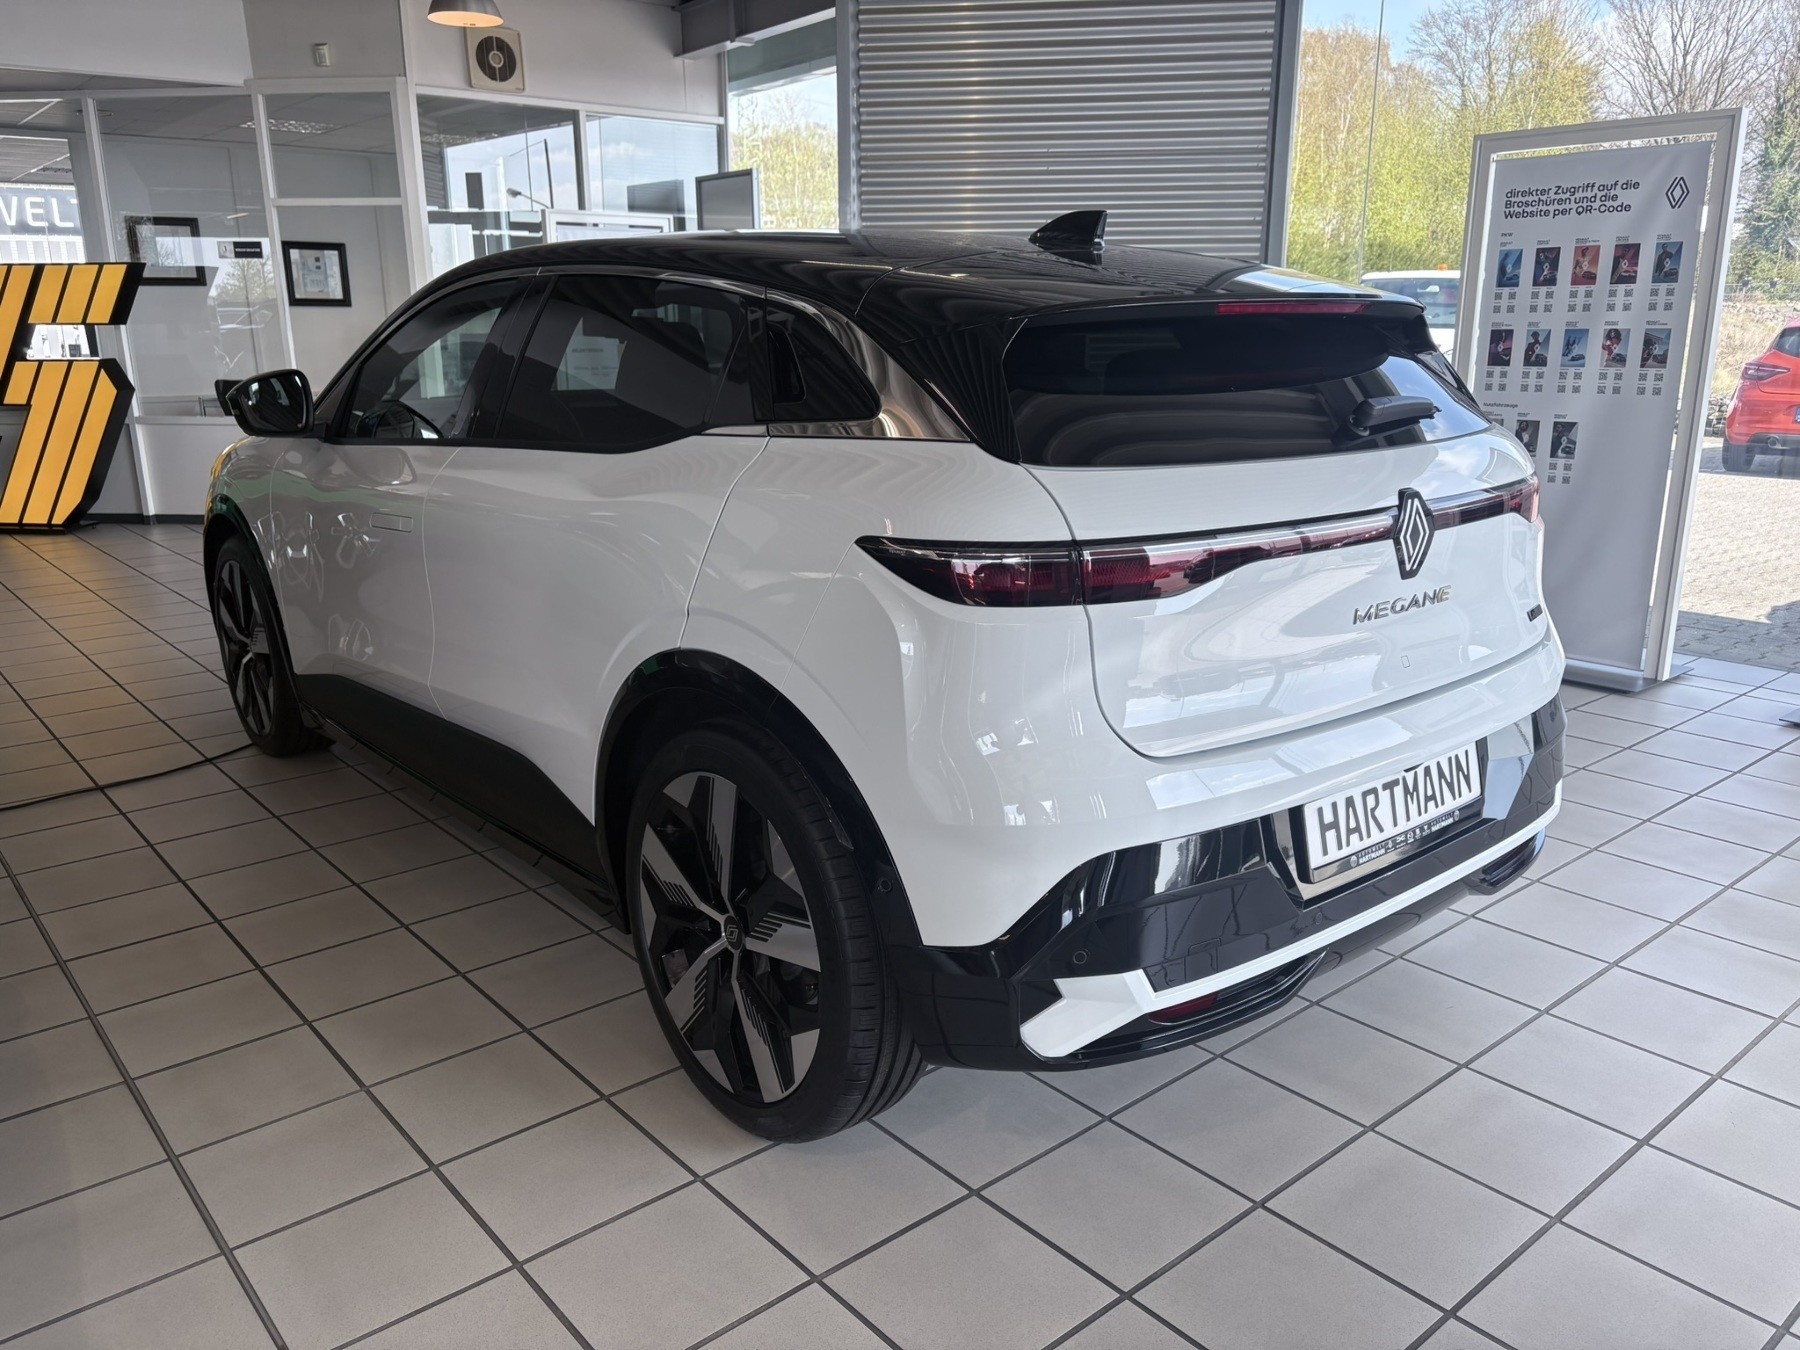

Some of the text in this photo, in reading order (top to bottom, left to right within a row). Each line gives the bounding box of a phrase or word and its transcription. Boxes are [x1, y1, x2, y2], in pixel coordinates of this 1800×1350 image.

[1505, 179, 1640, 199] direkter Zugriff auf die
[1504, 192, 1618, 209] Broschüren und die
[1504, 202, 1632, 219] Website per QR-Code
[1352, 585, 1452, 624] MEGANE
[1317, 749, 1472, 857] HARTMANN
